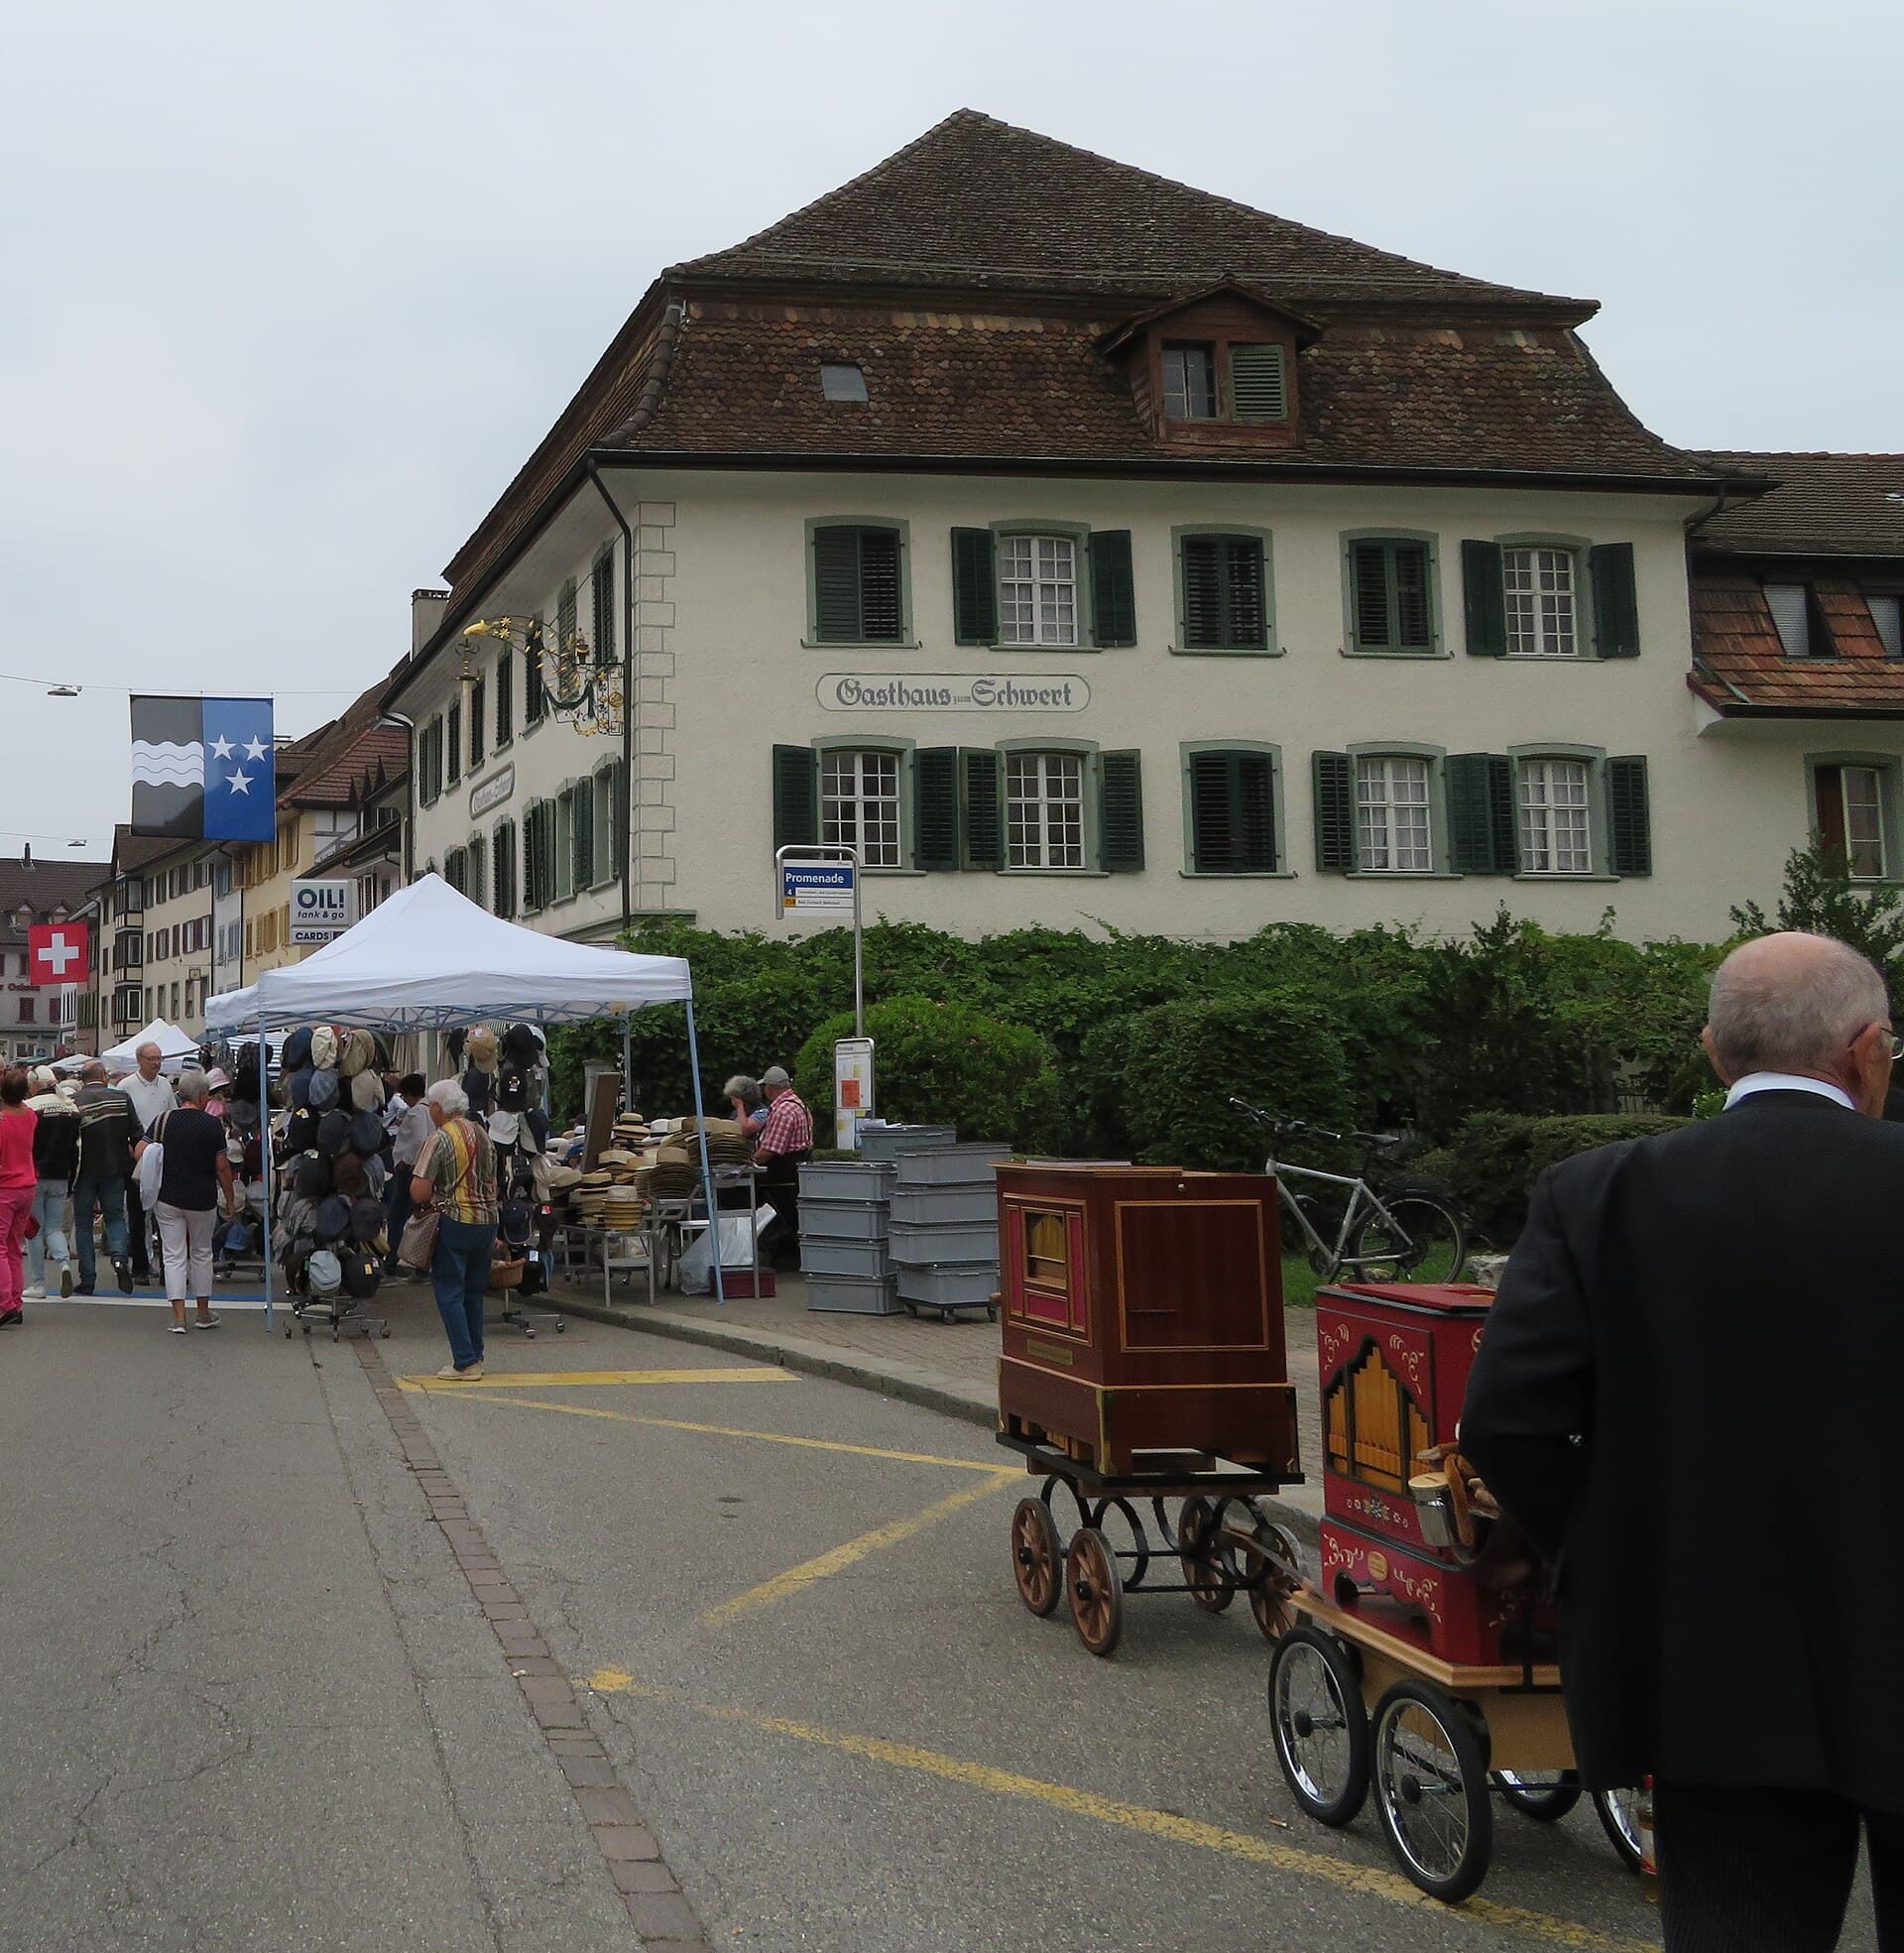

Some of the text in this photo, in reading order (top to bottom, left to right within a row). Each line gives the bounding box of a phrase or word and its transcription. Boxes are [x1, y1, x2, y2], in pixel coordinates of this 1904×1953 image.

[836, 678, 1072, 707] Gasthaus zum Schwert
[785, 873, 844, 884] Promenade
[298, 889, 344, 909] OIL!
